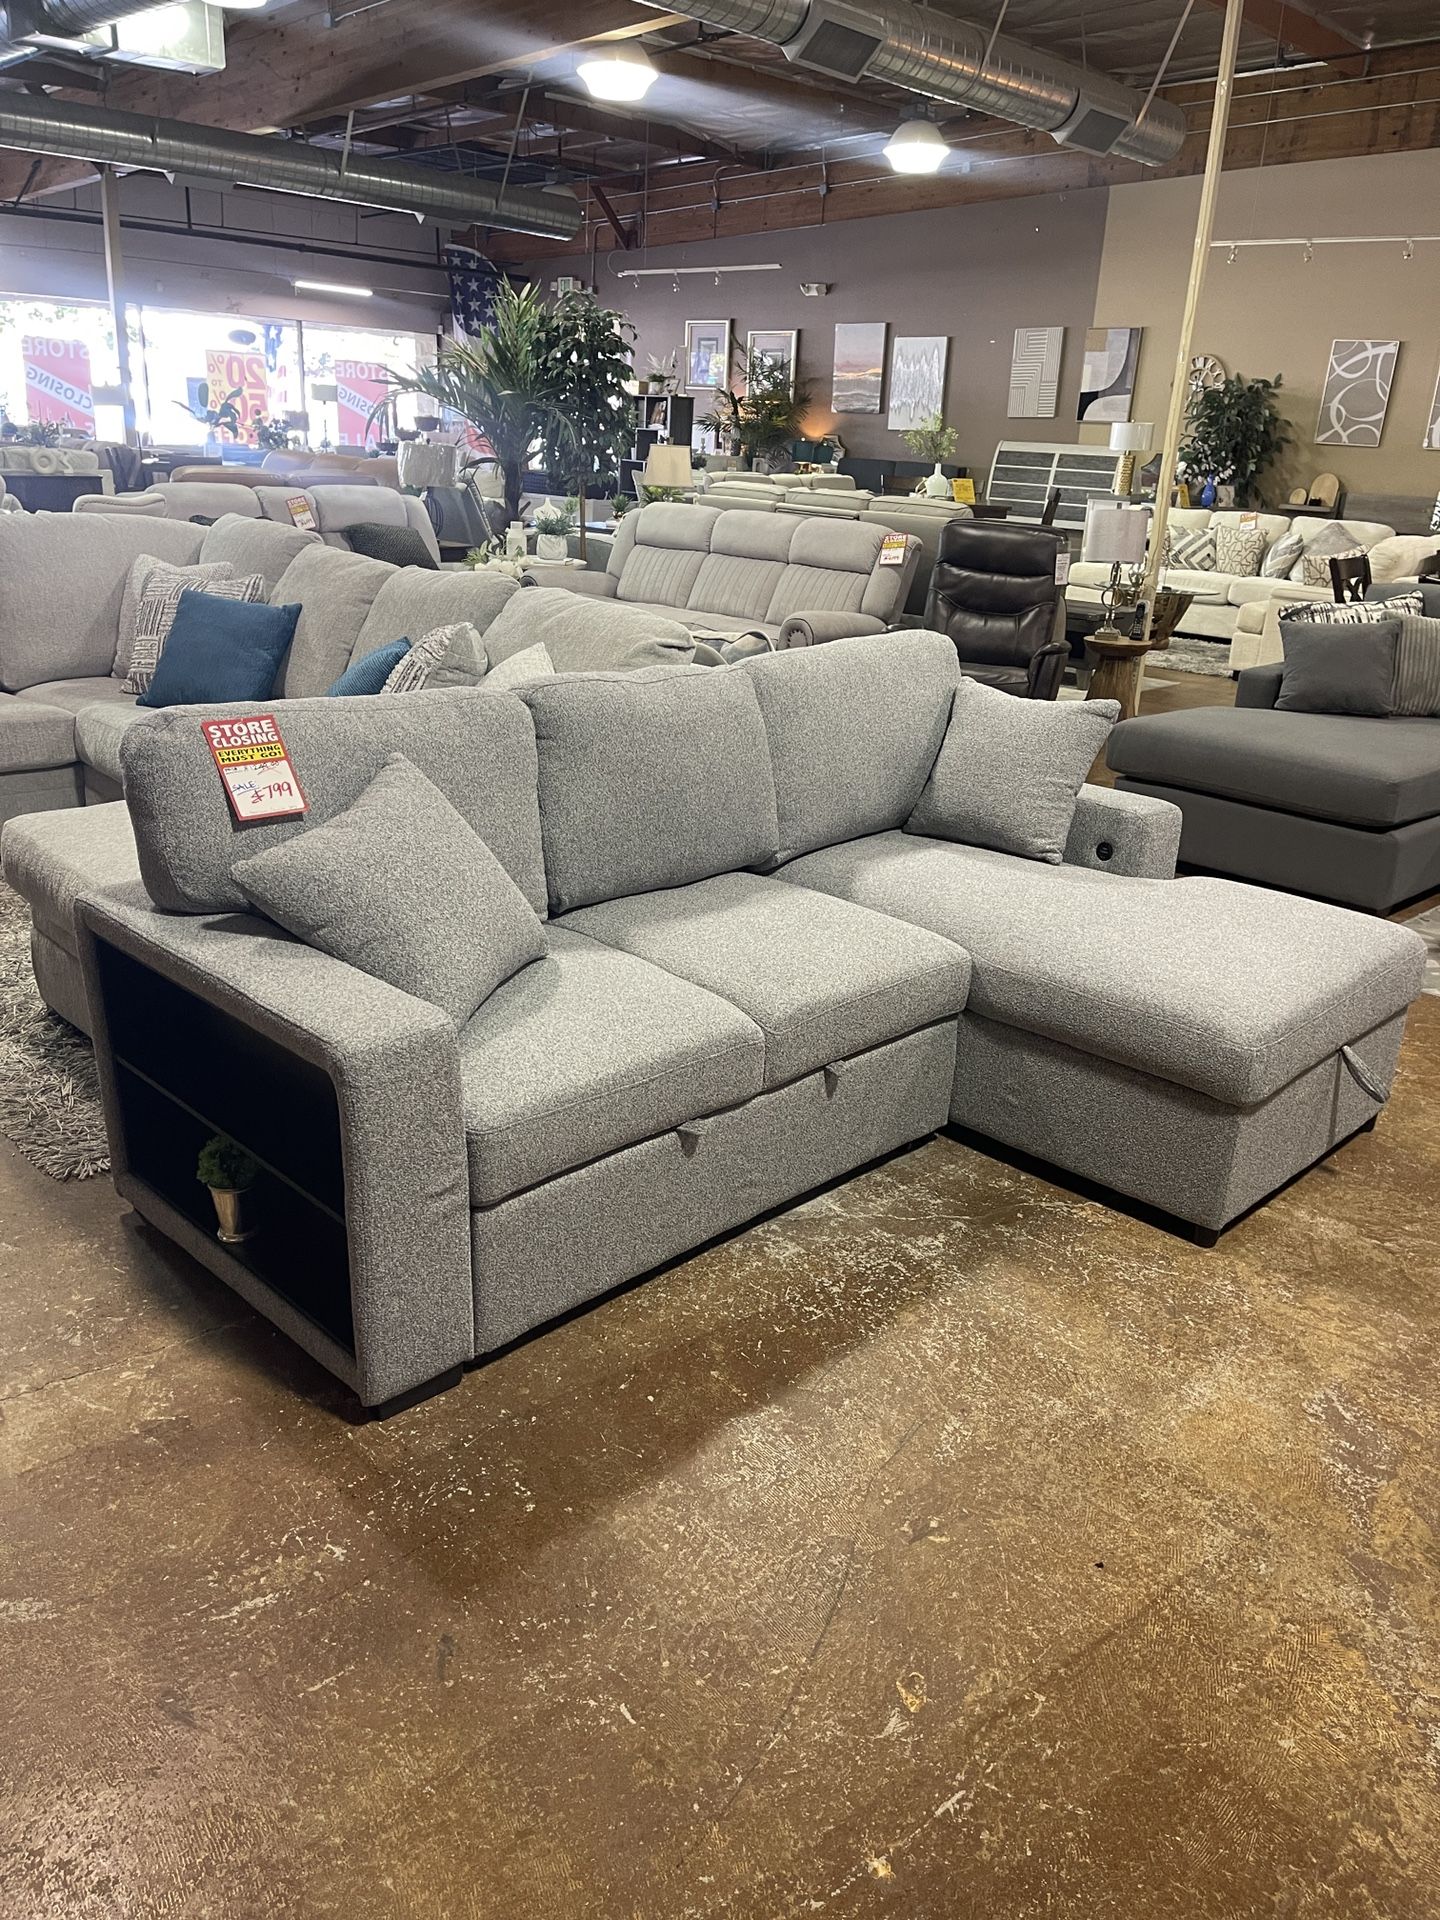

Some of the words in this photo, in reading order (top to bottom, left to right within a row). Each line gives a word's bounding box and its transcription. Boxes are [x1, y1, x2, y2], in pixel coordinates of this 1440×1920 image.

[208, 720, 275, 738] STORE
[212, 732, 279, 748] CLOSING
[218, 744, 281, 757] EVERYTHING
[221, 754, 254, 764] MUST
[261, 751, 282, 759] GO!
[232, 781, 256, 790] SALE
[251, 781, 293, 805] $799
